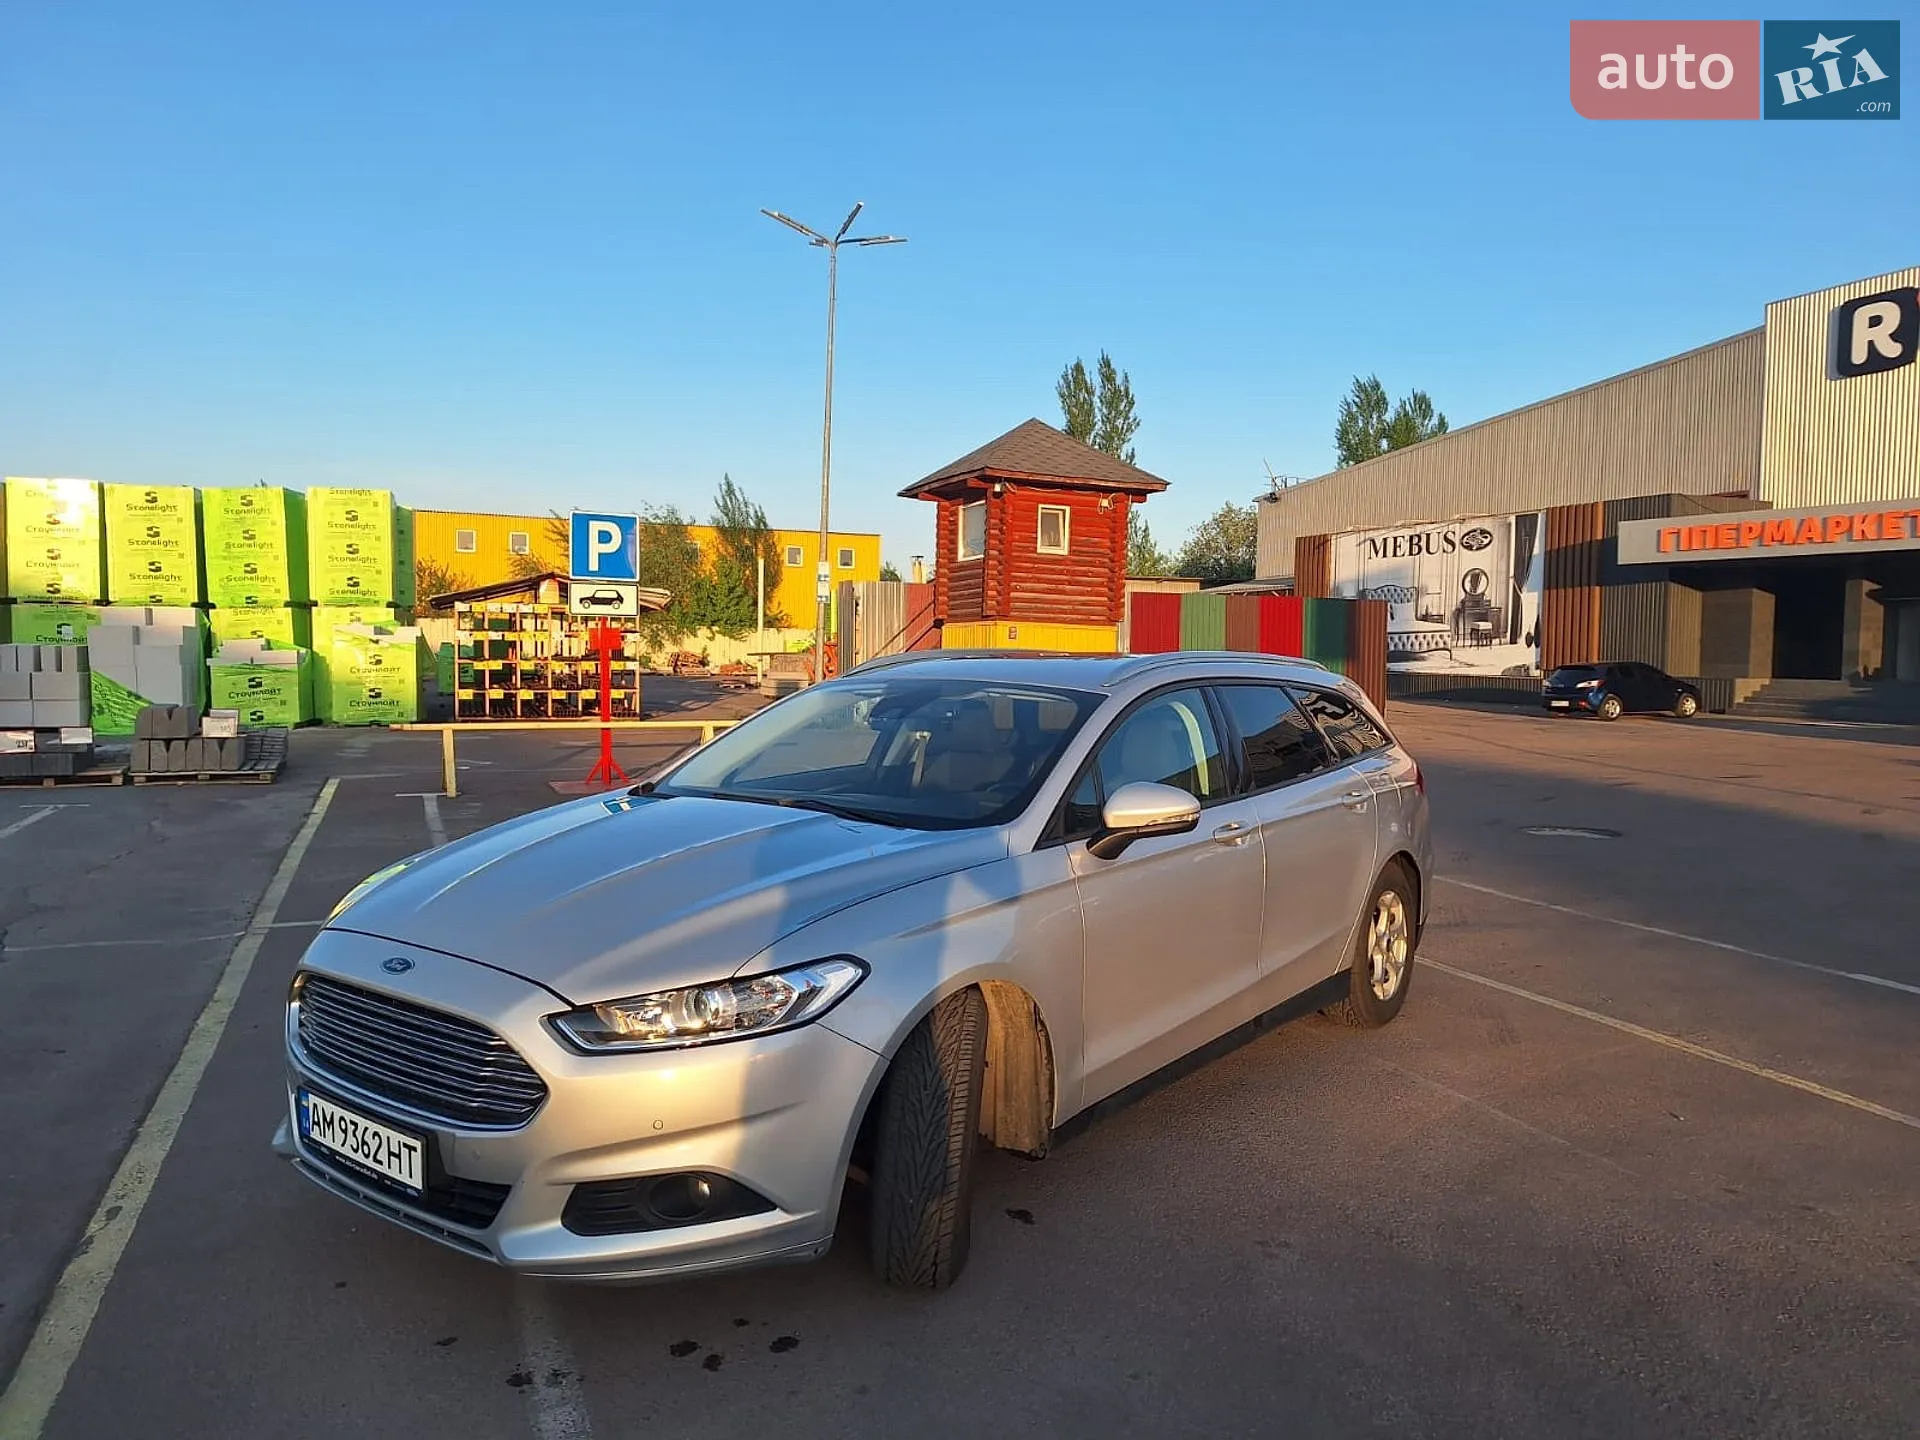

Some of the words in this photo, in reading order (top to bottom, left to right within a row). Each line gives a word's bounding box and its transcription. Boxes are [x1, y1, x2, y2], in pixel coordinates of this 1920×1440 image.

[1851, 301, 1903, 365] R
[587, 520, 622, 572] P
[1367, 530, 1458, 560] MEBUS
